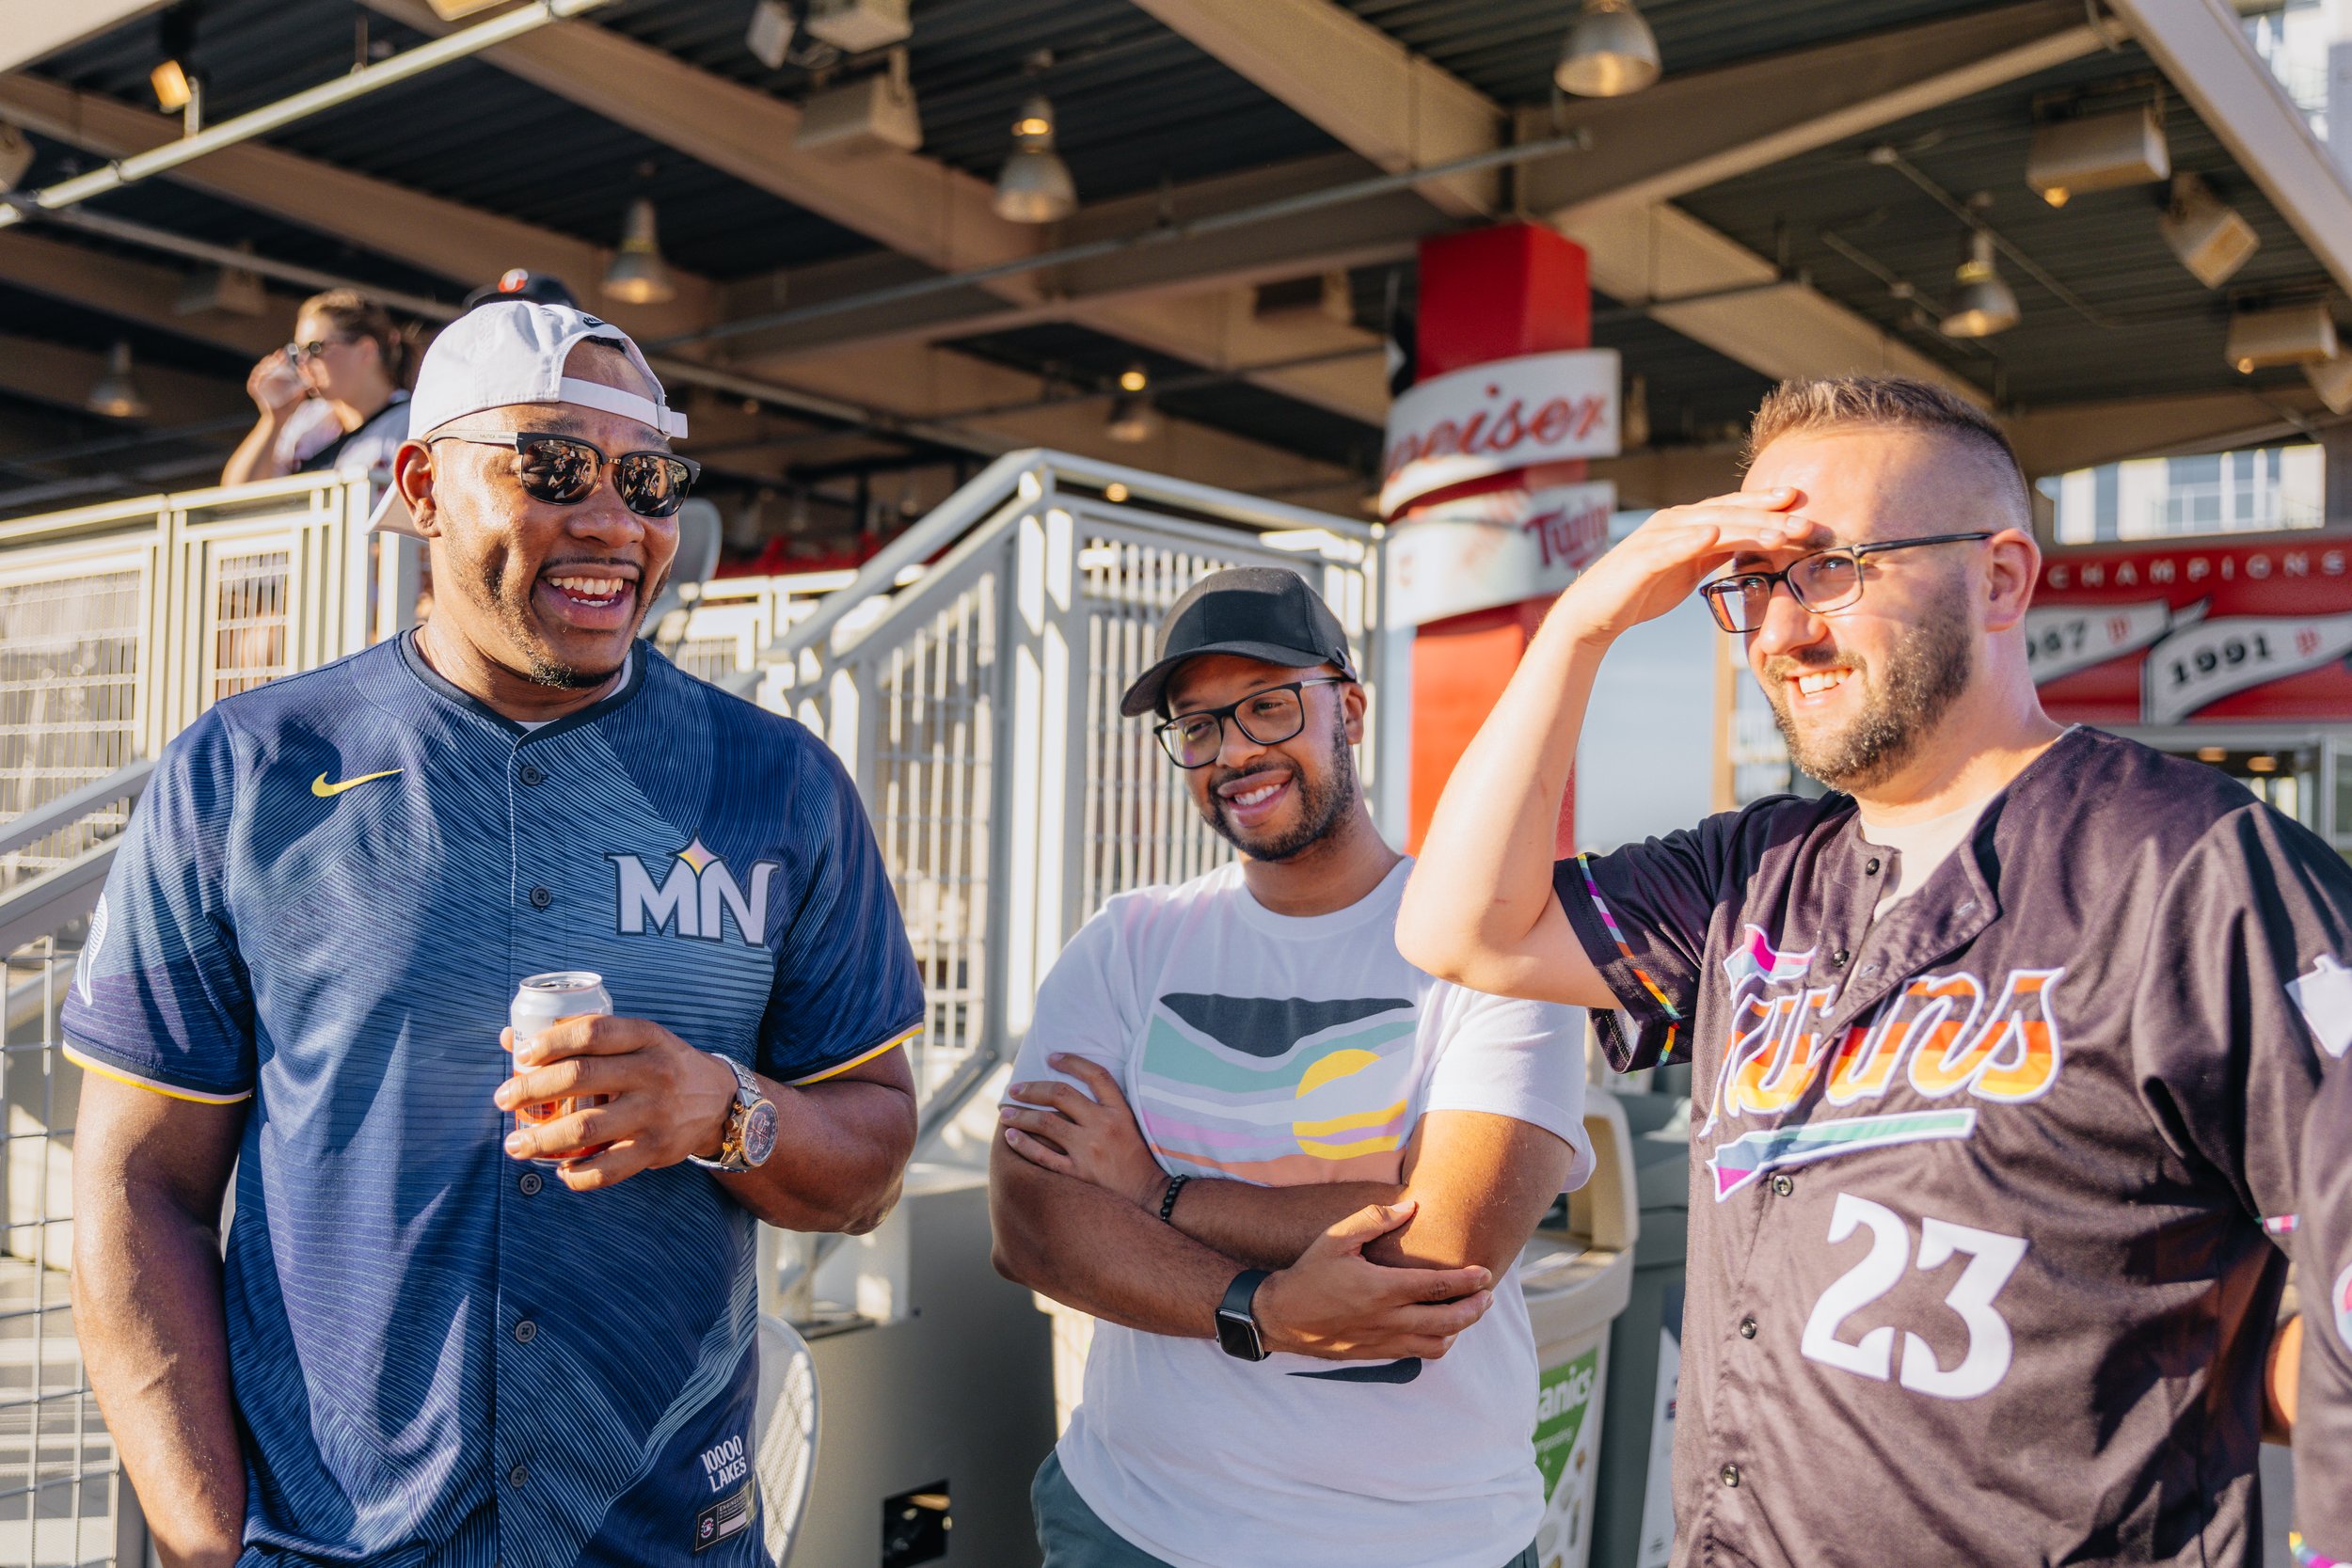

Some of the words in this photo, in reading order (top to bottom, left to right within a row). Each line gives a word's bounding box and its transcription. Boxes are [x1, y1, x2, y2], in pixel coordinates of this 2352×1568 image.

[2046, 549, 2346, 590] CHAMPIONS
[2172, 632, 2270, 684] 1991
[603, 832, 782, 949] MN
[1800, 1192, 2030, 1401] 23
[708, 1456, 747, 1493] LAKES
